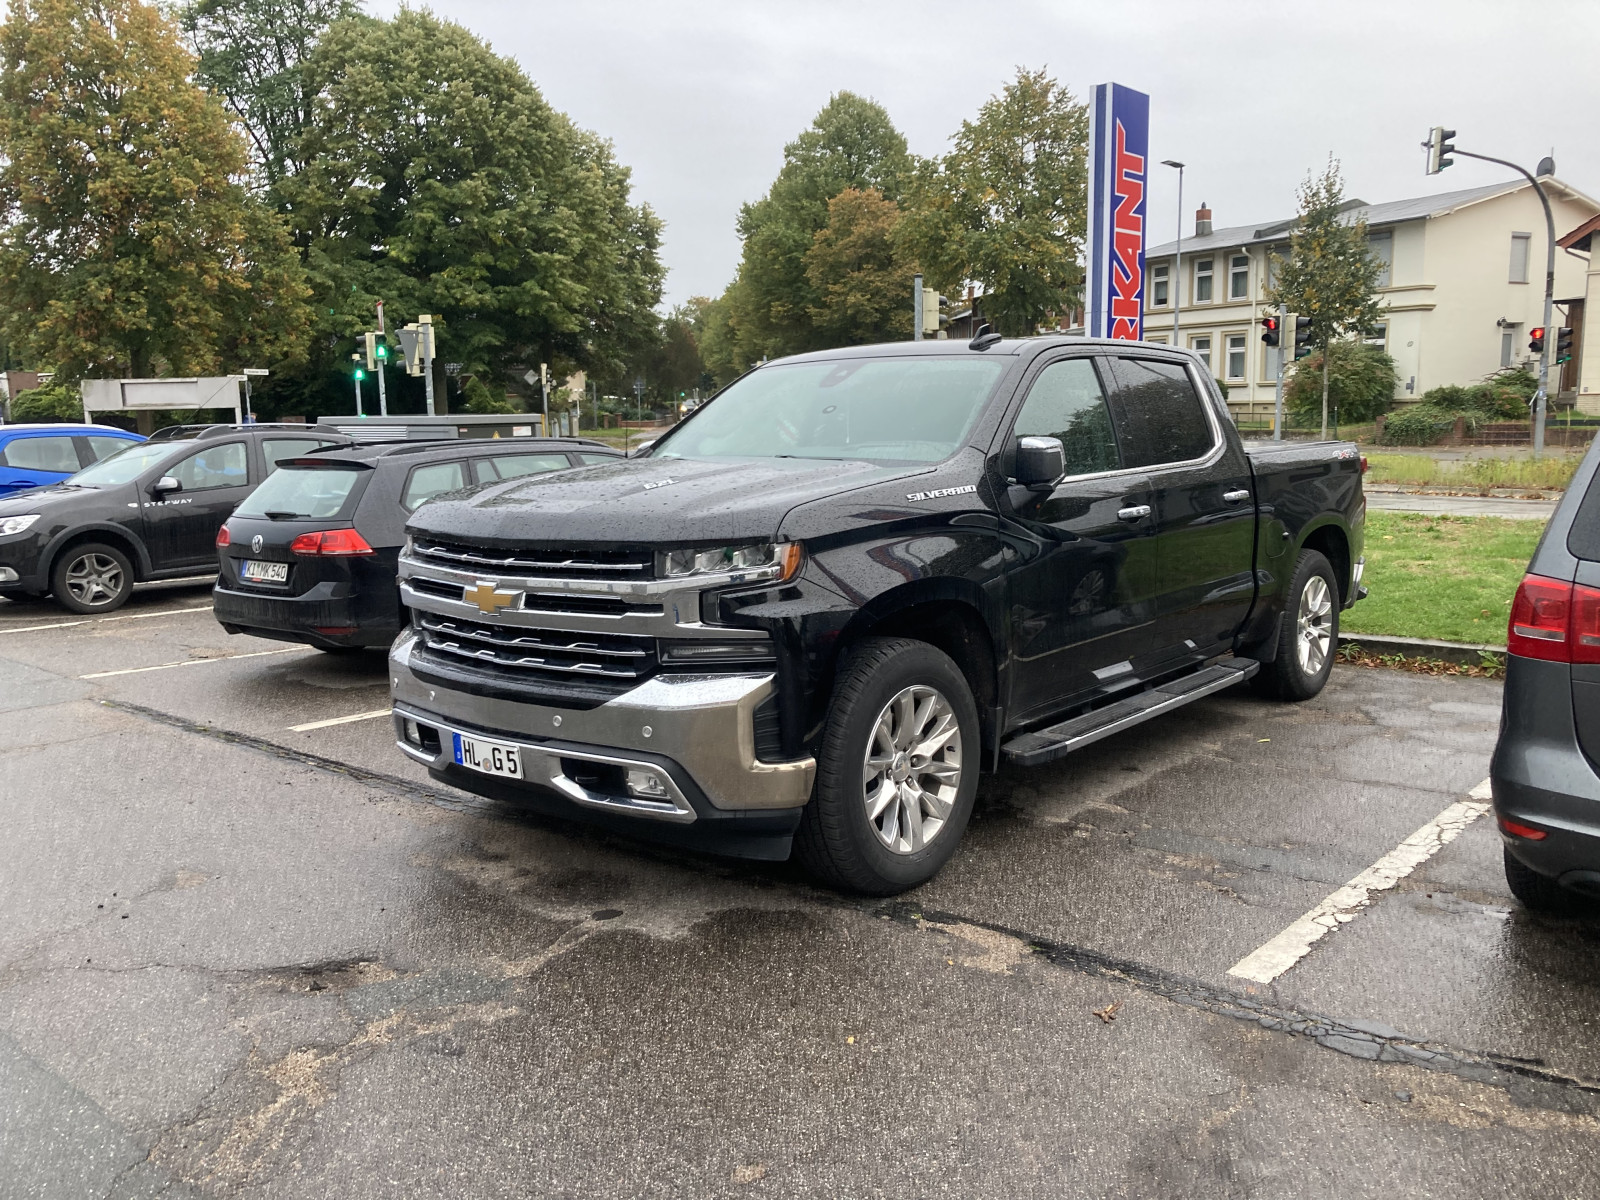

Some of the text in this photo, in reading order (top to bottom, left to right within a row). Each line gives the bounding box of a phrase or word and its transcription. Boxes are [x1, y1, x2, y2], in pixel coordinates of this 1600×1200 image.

[906, 485, 976, 503] SILVERADO
[144, 499, 192, 508] STEPWAY
[463, 740, 480, 767] HL
